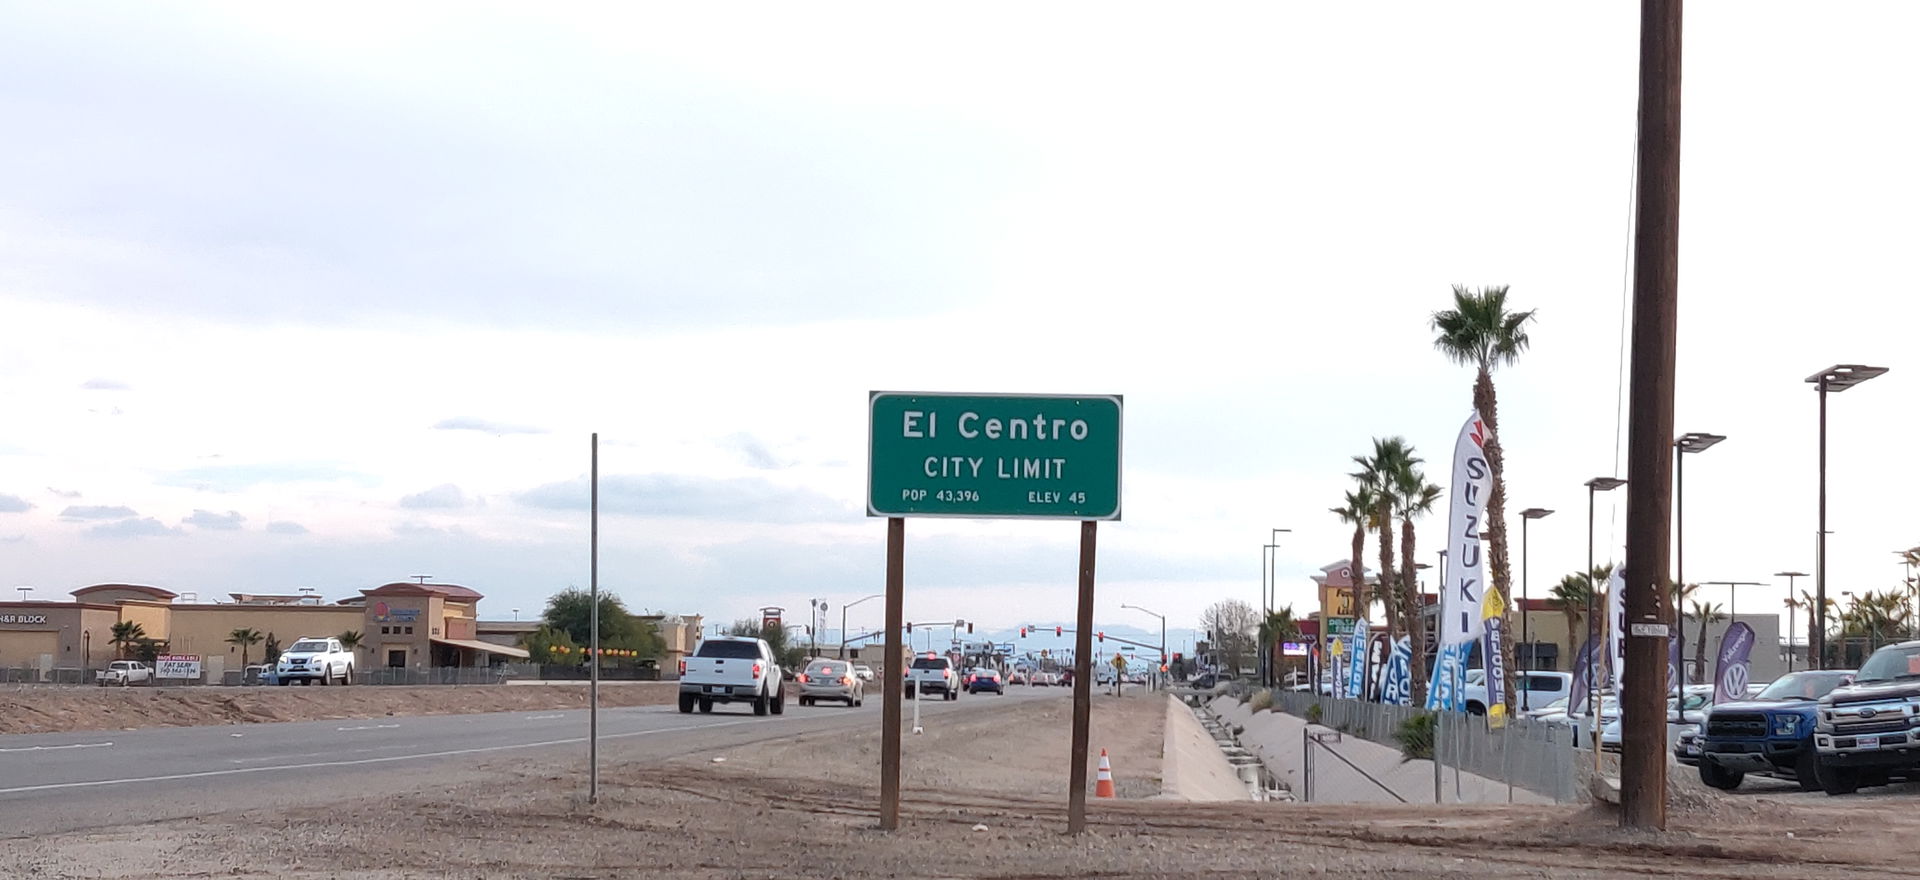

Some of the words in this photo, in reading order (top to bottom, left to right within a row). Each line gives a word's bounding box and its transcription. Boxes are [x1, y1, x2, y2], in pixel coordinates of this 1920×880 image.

[903, 411, 936, 438] El
[958, 411, 1089, 441] Centro
[924, 456, 984, 478] CITY
[997, 457, 1067, 479] LIMIT
[902, 489, 927, 502] POP
[936, 489, 980, 503] 43,396
[1028, 491, 1061, 504] ELEV
[1068, 491, 1086, 504] 45
[1459, 456, 1487, 633] SUZUKI
[18, 615, 47, 624] BLOCK
